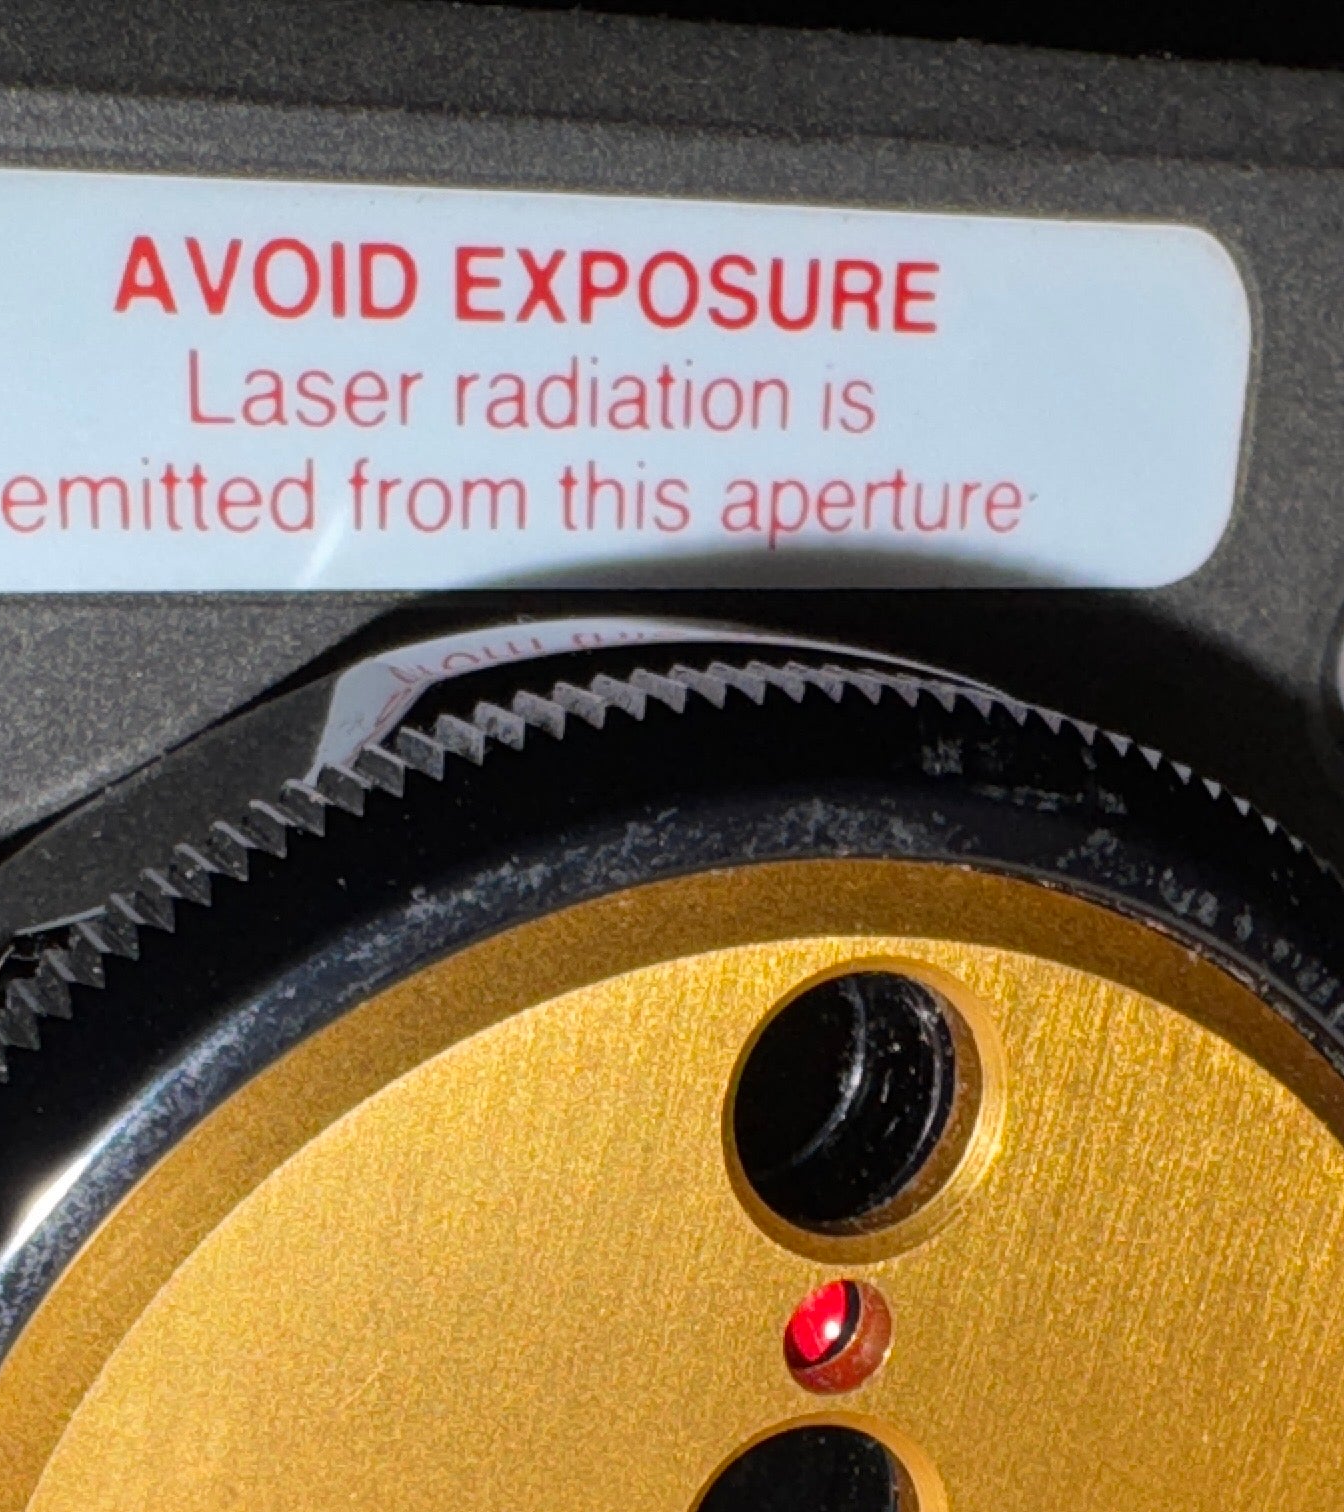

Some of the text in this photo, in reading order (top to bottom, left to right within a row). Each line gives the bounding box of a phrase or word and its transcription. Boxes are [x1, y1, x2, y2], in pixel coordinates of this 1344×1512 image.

[113, 234, 942, 336] AVOID EXPOSURE
[188, 352, 877, 434] Laser radiation is
[0, 460, 1024, 550] emitted from this aperture
